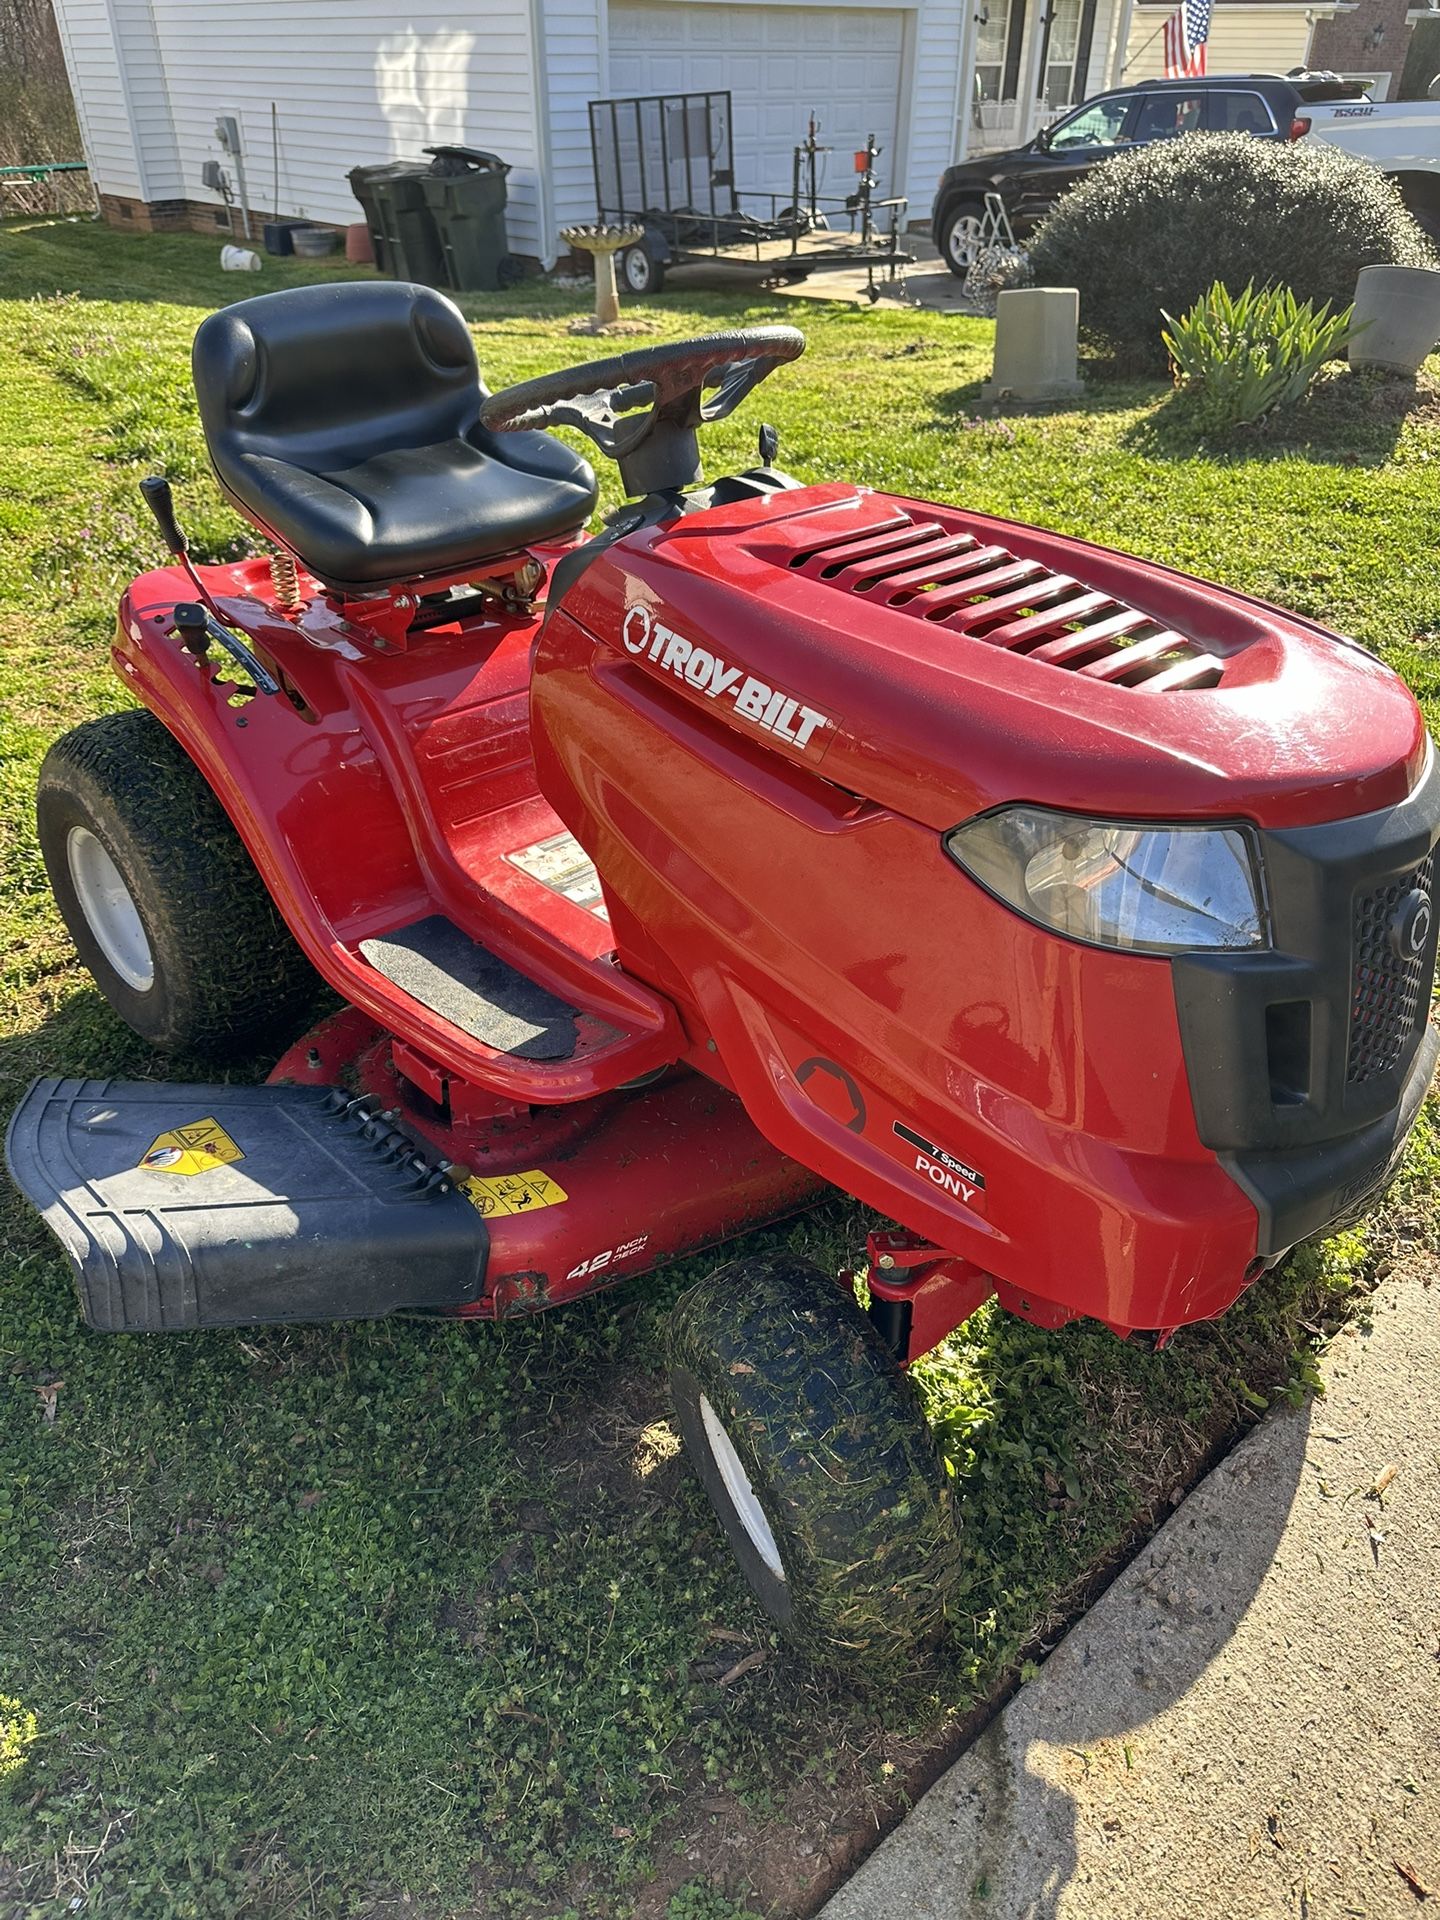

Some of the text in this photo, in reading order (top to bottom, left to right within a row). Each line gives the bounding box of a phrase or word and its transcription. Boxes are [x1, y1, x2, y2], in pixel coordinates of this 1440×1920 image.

[647, 622, 828, 750] TROY-BILT
[915, 1154, 976, 1202] PONY
[931, 1146, 977, 1182] 7 Speed
[612, 1243, 647, 1262] DECK
[616, 1235, 648, 1253] INCH
[566, 1250, 613, 1280] 42
